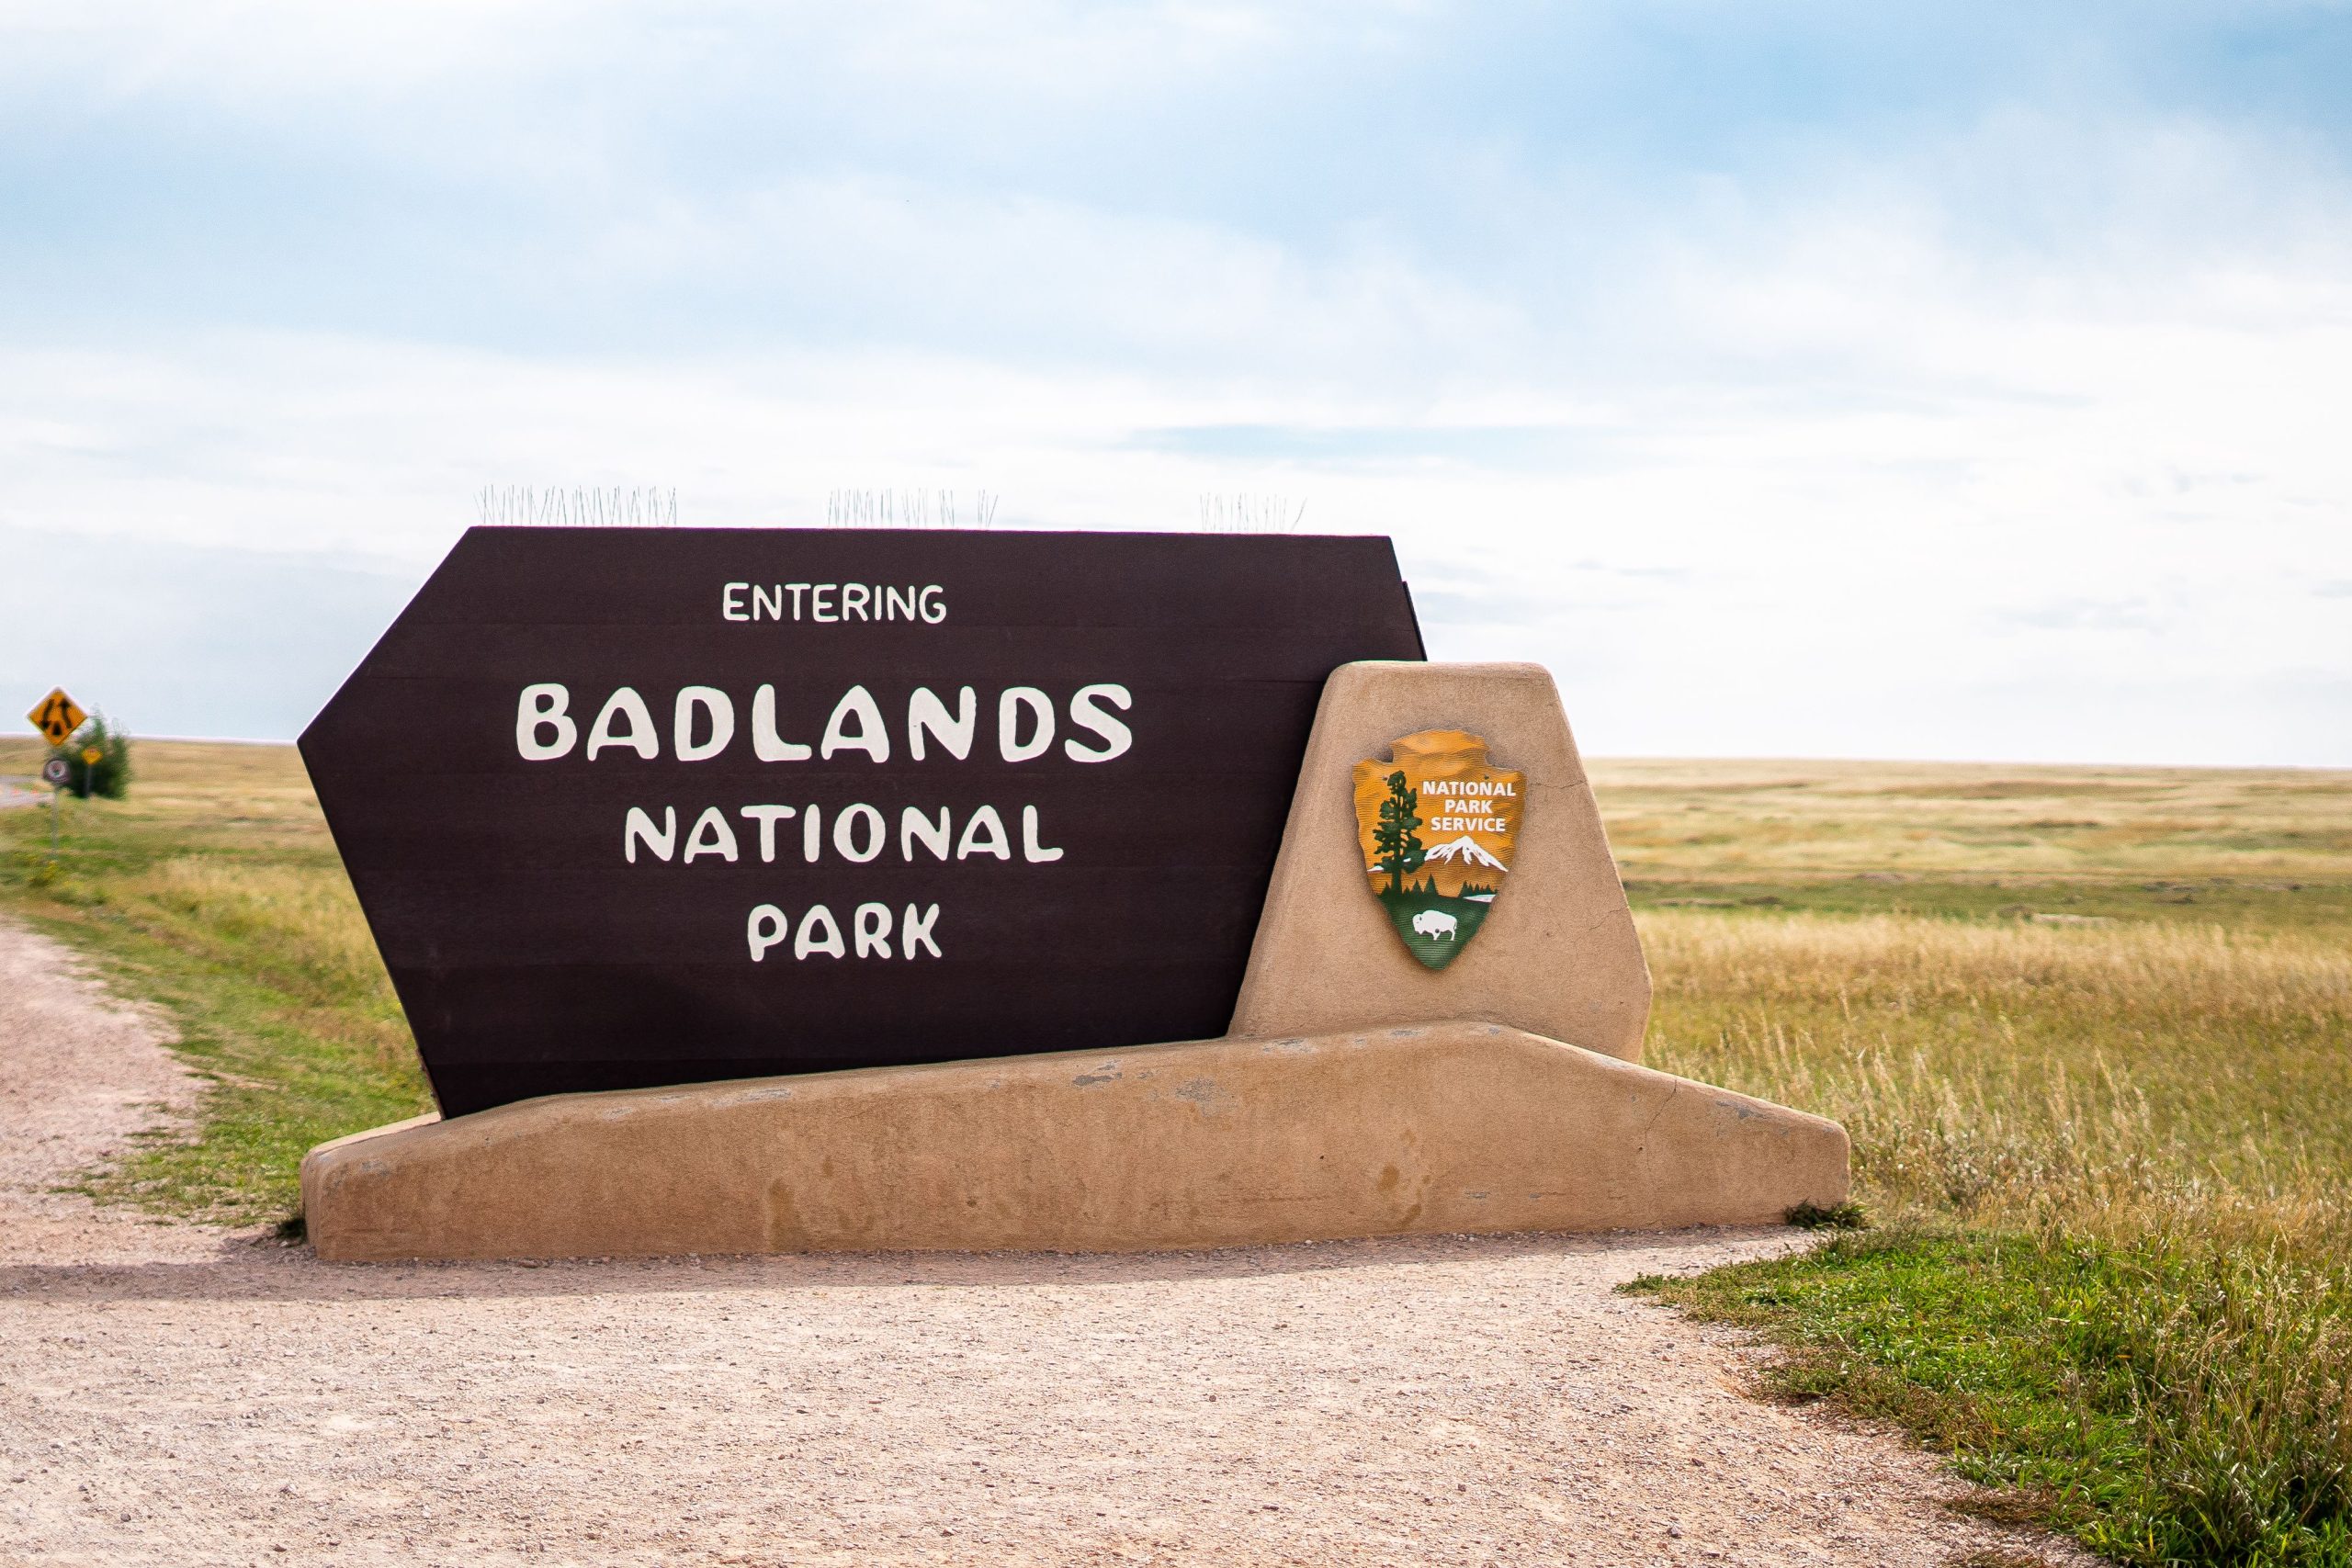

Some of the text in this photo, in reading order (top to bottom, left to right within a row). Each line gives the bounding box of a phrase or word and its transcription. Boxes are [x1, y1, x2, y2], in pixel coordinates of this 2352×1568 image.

[723, 582, 946, 624] ENTERING
[516, 683, 1132, 762] BADLANDS
[1423, 782, 1516, 796] NATIONAL
[1445, 800, 1492, 813] PARK
[626, 804, 1063, 863] NATIONAL
[1431, 818, 1505, 831] SERVICE
[748, 903, 942, 962] PARK
